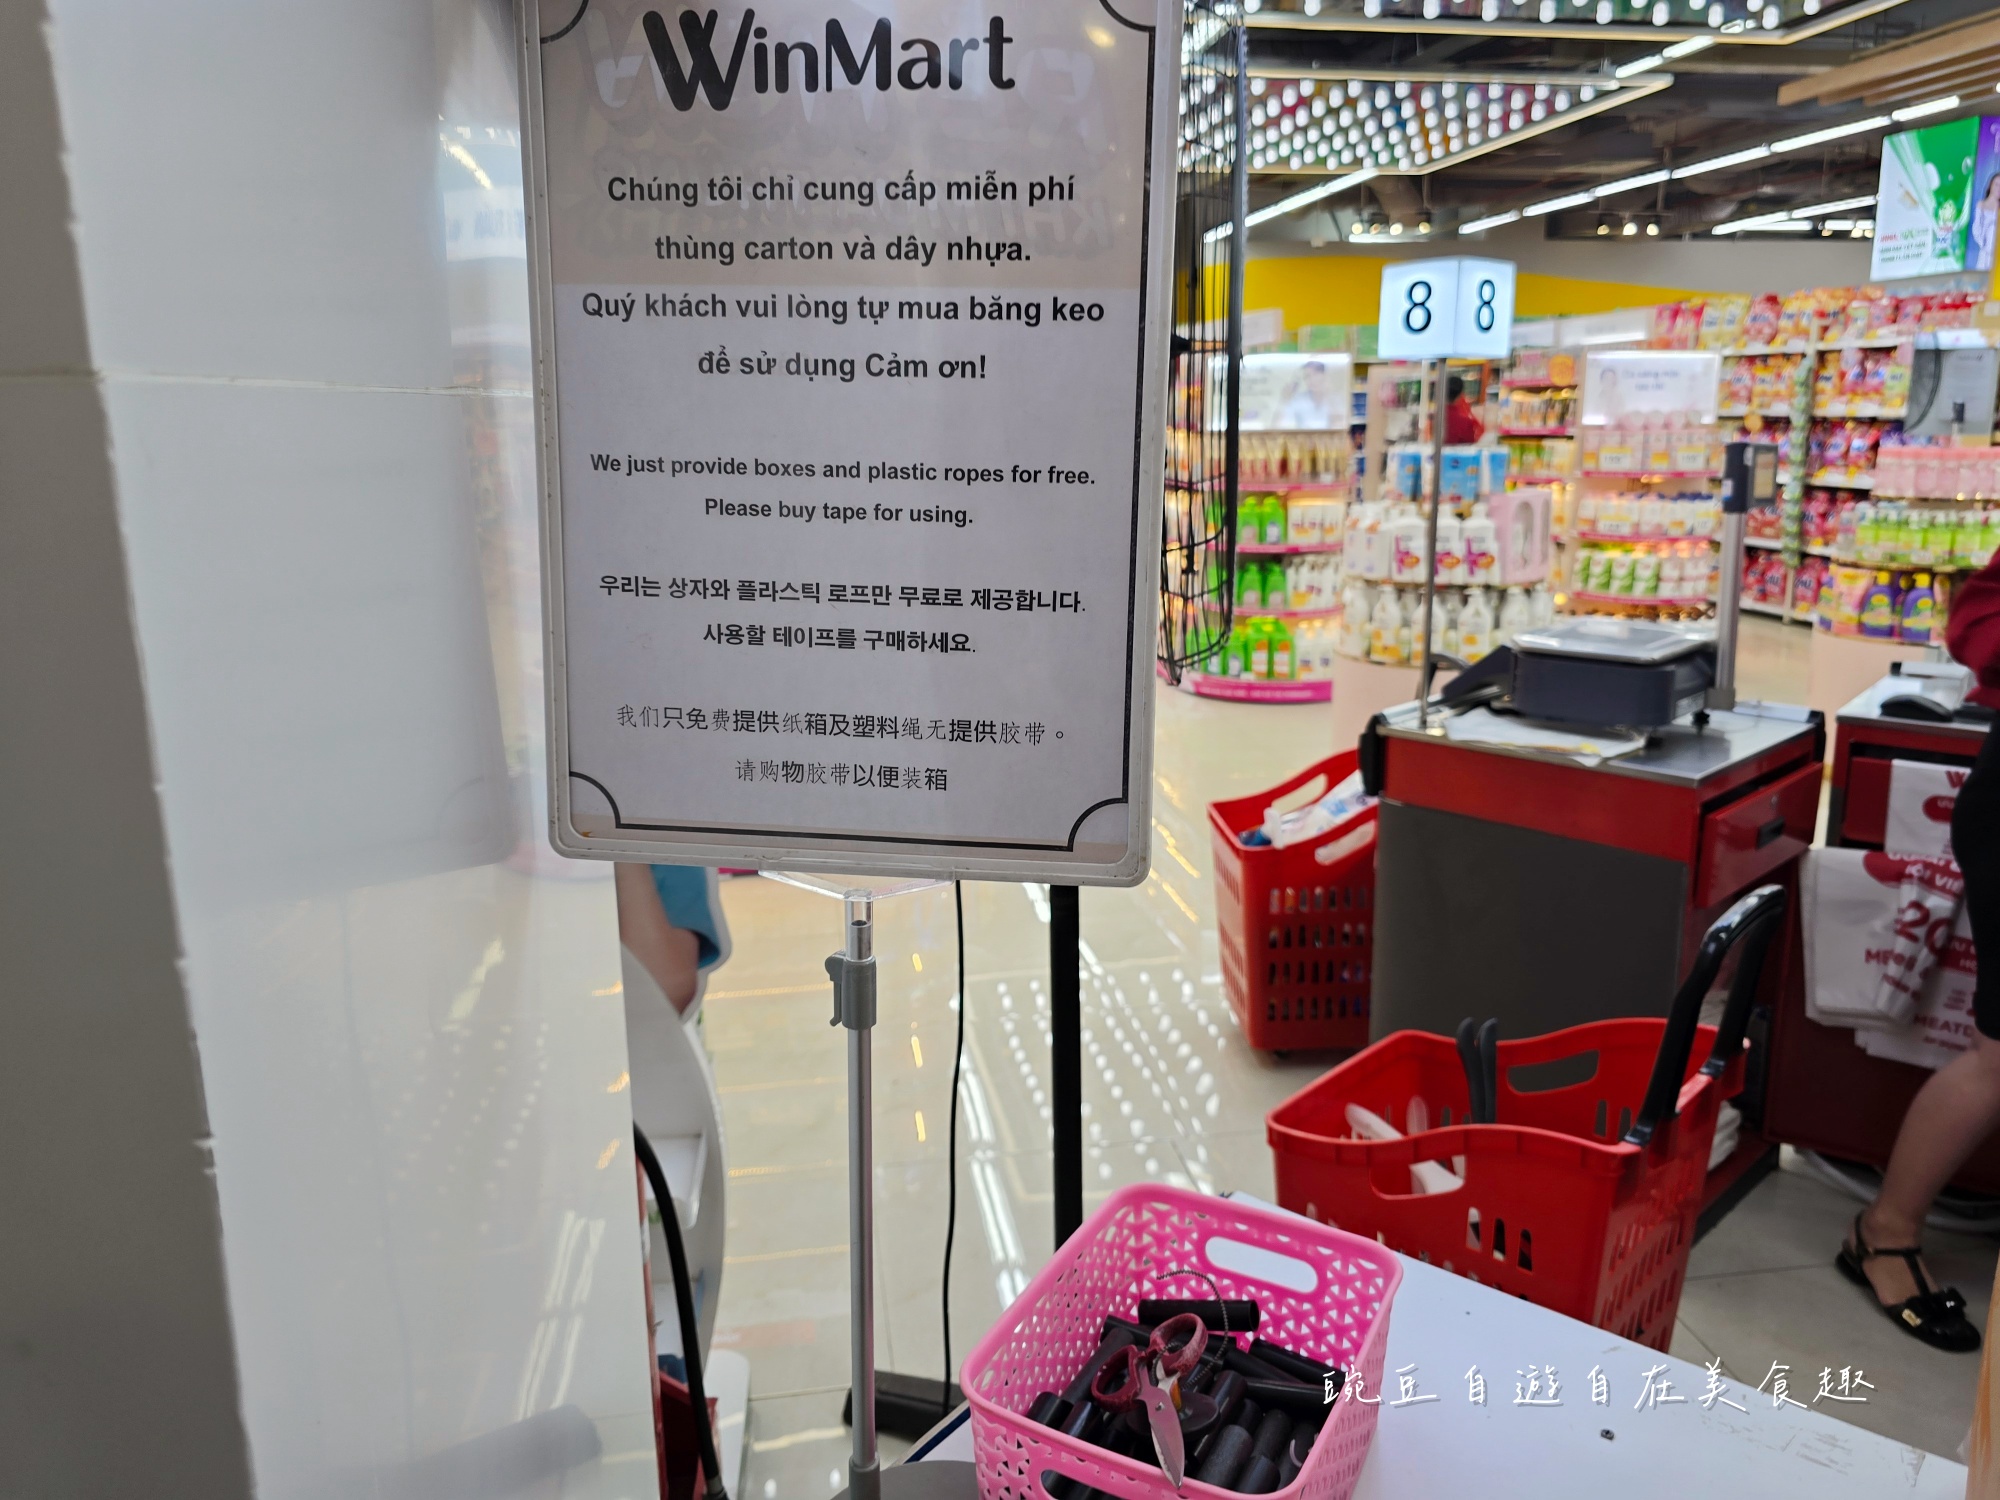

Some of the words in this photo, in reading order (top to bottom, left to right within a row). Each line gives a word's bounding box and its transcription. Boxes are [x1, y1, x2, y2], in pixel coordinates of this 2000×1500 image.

[641, 7, 1015, 111] WinMart
[607, 176, 699, 207] Chúng
[707, 175, 742, 202] tôi
[752, 174, 794, 201] chỉ
[803, 181, 874, 207] cung
[884, 169, 936, 207] cấp
[946, 169, 1017, 201] miễn
[1028, 174, 1075, 208] phí
[654, 234, 735, 267] thùng
[744, 236, 833, 260] carton
[842, 234, 876, 261] và
[885, 234, 937, 267] dây
[947, 235, 1031, 268] nhựa.
[582, 292, 636, 323] Quý
[645, 292, 727, 318] khách
[735, 293, 777, 318] vui
[787, 293, 848, 326] lòng
[856, 297, 890, 326] tự
[898, 300, 959, 321] mua
[969, 295, 1041, 328] băng
[1052, 296, 1105, 322] keo
[1405, 281, 1432, 332] 8
[1477, 279, 1496, 331] 8
[697, 344, 731, 375] để
[739, 350, 777, 376] sử
[785, 352, 855, 383] dụng
[865, 352, 928, 378] Cảm
[938, 354, 986, 379] ơn!
[590, 453, 622, 472] We
[625, 454, 665, 477] just
[671, 456, 748, 478] provide
[754, 457, 816, 478] boxes
[822, 460, 861, 479] and
[868, 461, 938, 484] plastic
[944, 467, 1005, 487] ropes
[1010, 464, 1042, 484] for
[1047, 465, 1095, 485] free.
[705, 497, 772, 518] Please
[778, 500, 817, 523] buy
[822, 502, 868, 525] tape
[873, 503, 904, 522] for
[909, 504, 973, 528] using.
[599, 575, 662, 598] 우리는
[668, 577, 731, 601] 상자와
[736, 579, 820, 604] 플라스틱
[827, 583, 893, 607] 로프만
[898, 586, 964, 608] 무료로
[970, 588, 1086, 614] 제공합니다.
[702, 623, 767, 646] 사용할
[772, 625, 858, 650] 테이프를
[863, 629, 976, 654] 구매하세요.
[617, 703, 1064, 747] 我们只免费提供纸箱及塑料绳无提供胶带。
[735, 758, 948, 792] 请购物胶带以便装箱
